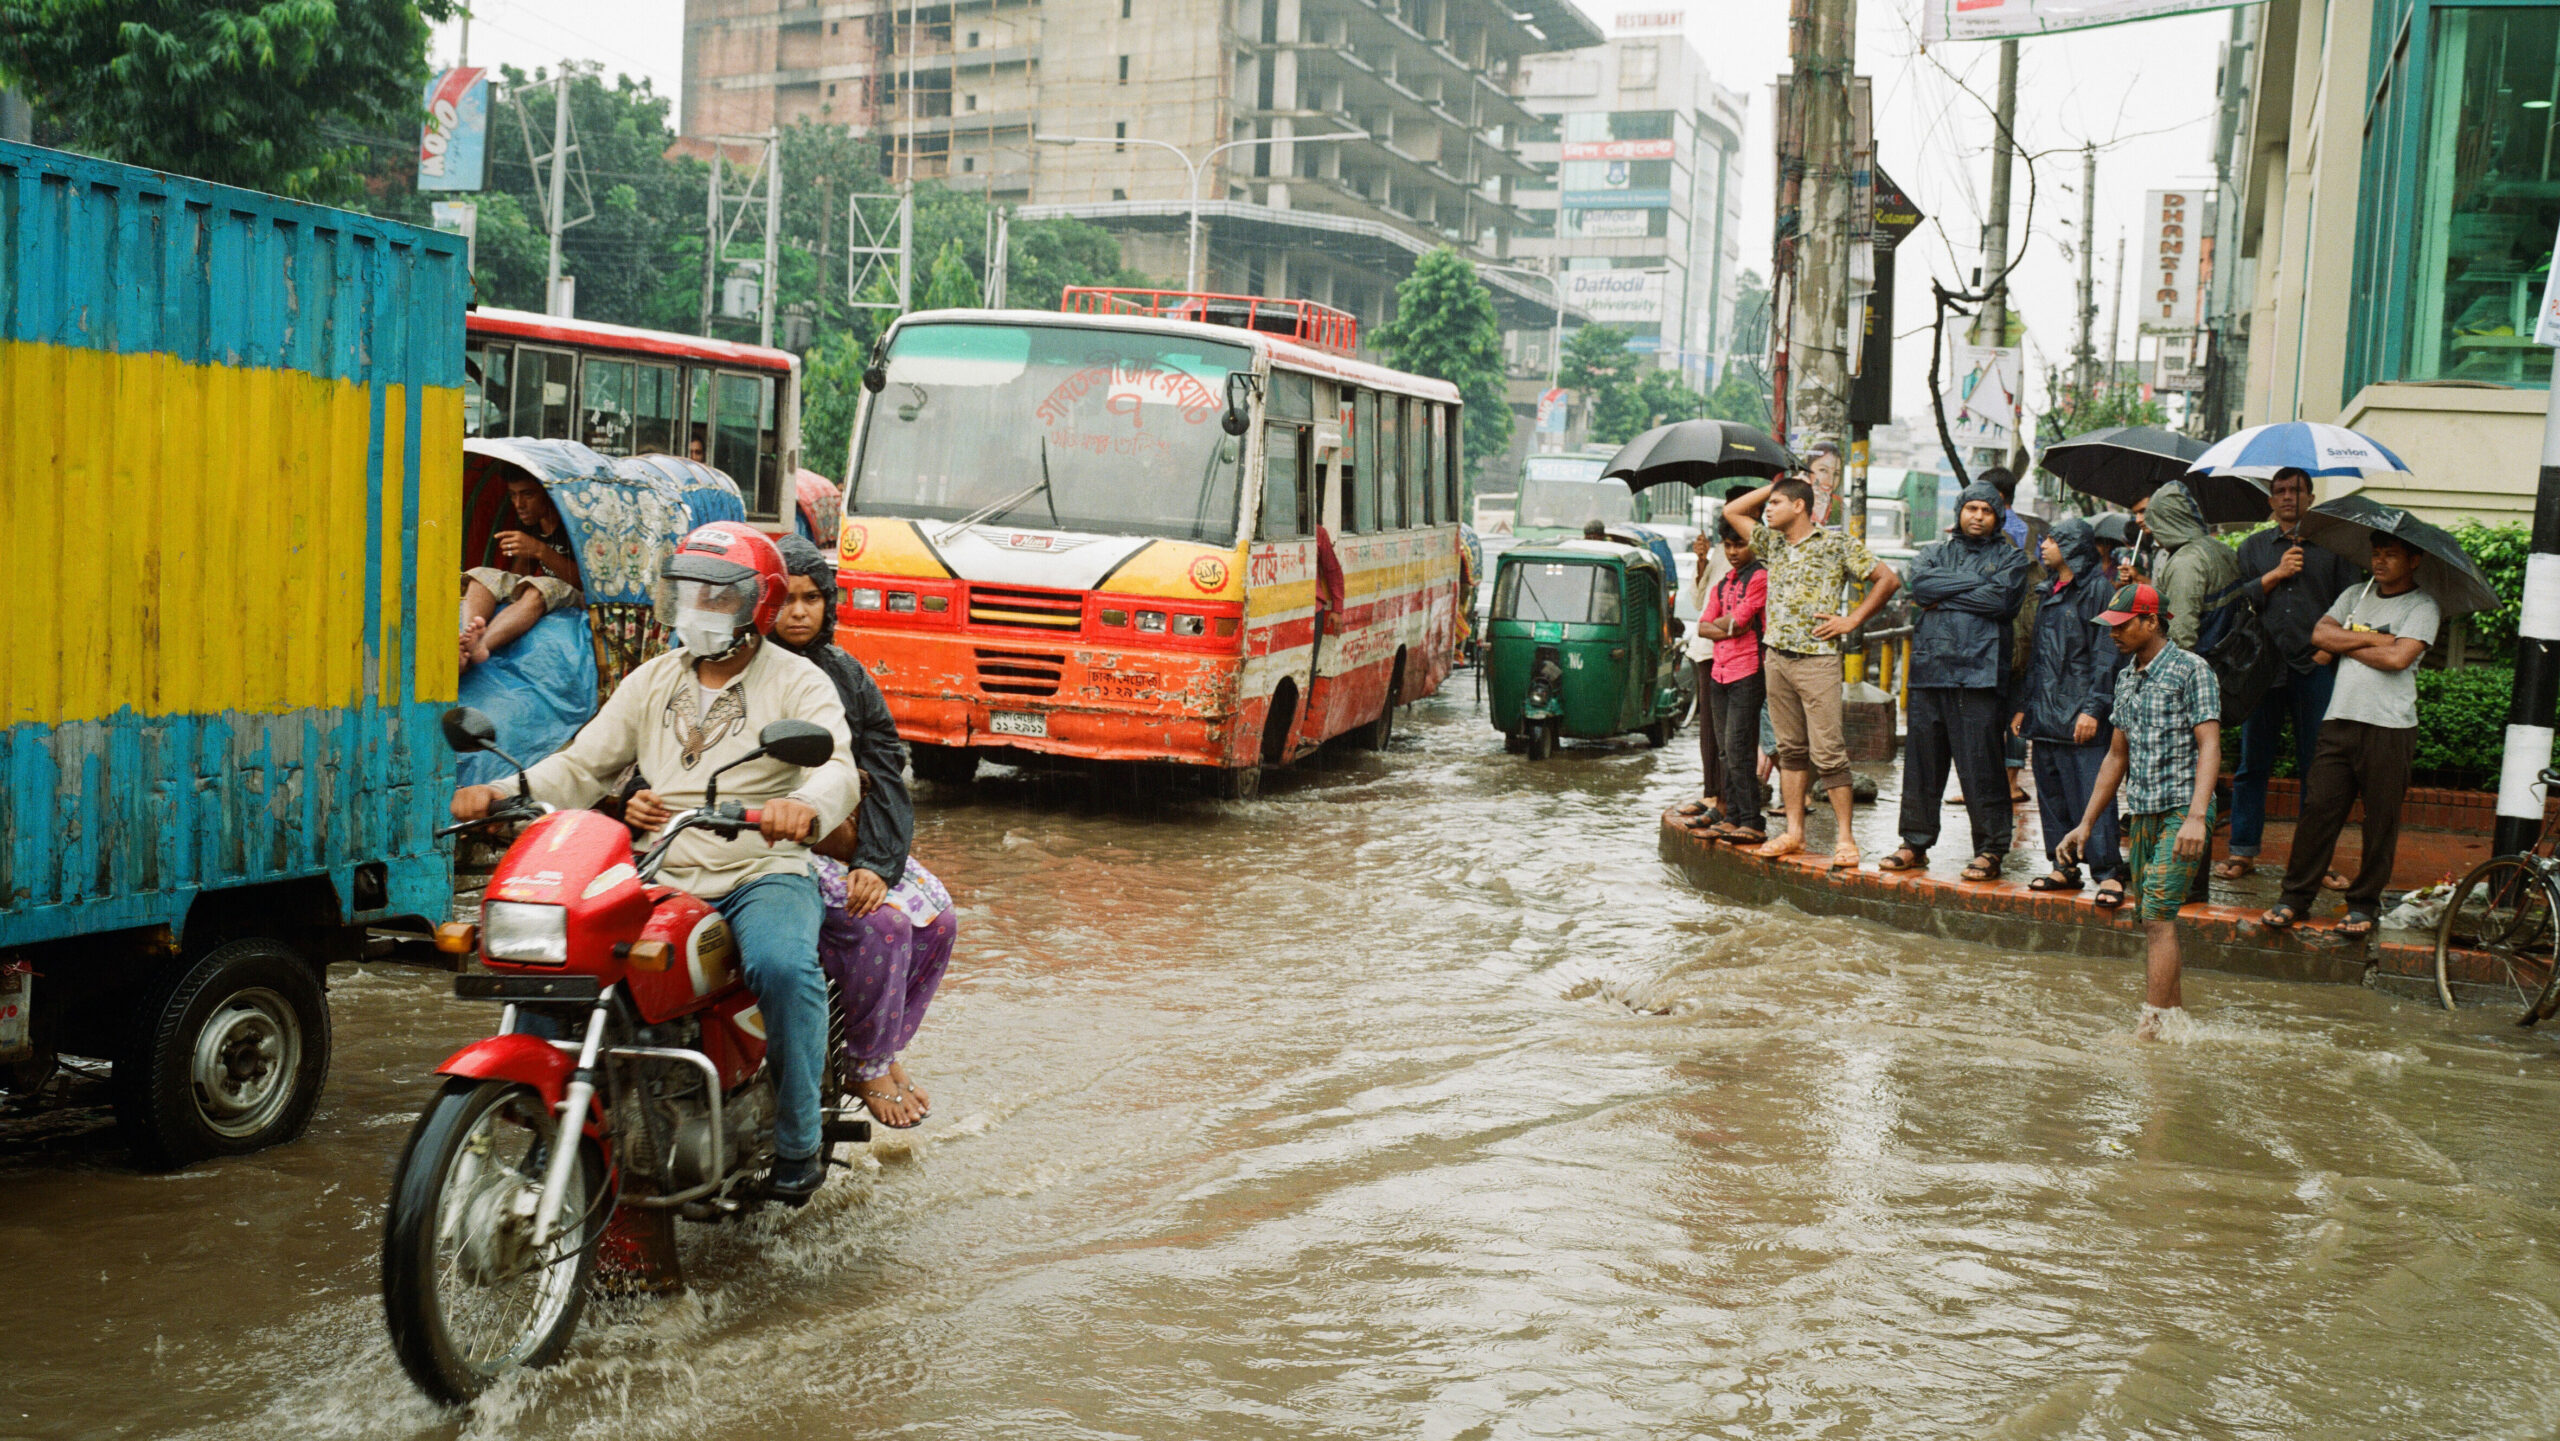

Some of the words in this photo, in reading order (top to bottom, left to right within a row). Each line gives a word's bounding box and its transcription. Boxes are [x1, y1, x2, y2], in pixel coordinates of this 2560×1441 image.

[1574, 276, 1645, 293] Daffodil
[1584, 298, 1656, 313] University
[1105, 393, 1143, 429] ৭
[2326, 447, 2368, 457] Savlon
